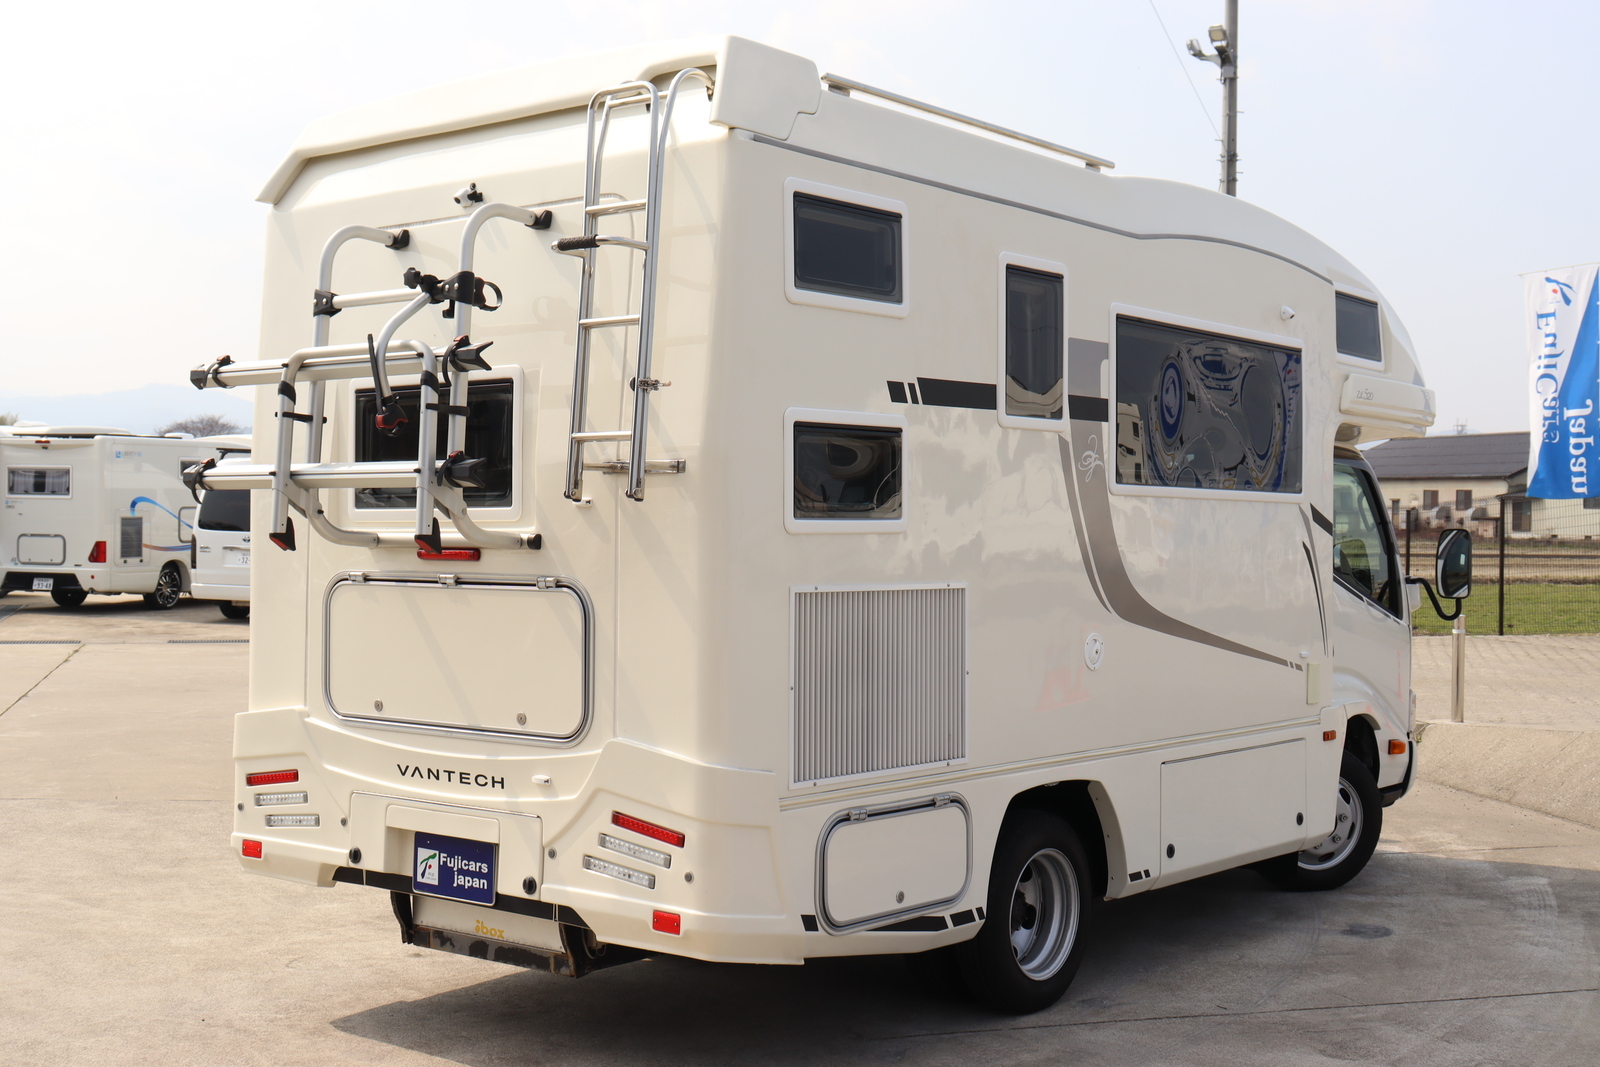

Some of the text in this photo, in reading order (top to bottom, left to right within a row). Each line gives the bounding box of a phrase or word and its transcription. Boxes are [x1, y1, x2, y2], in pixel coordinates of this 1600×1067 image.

[396, 763, 505, 790] VANTECH
[439, 852, 489, 873] Fujicars
[453, 871, 488, 890] japan
[474, 919, 505, 939] ibox
